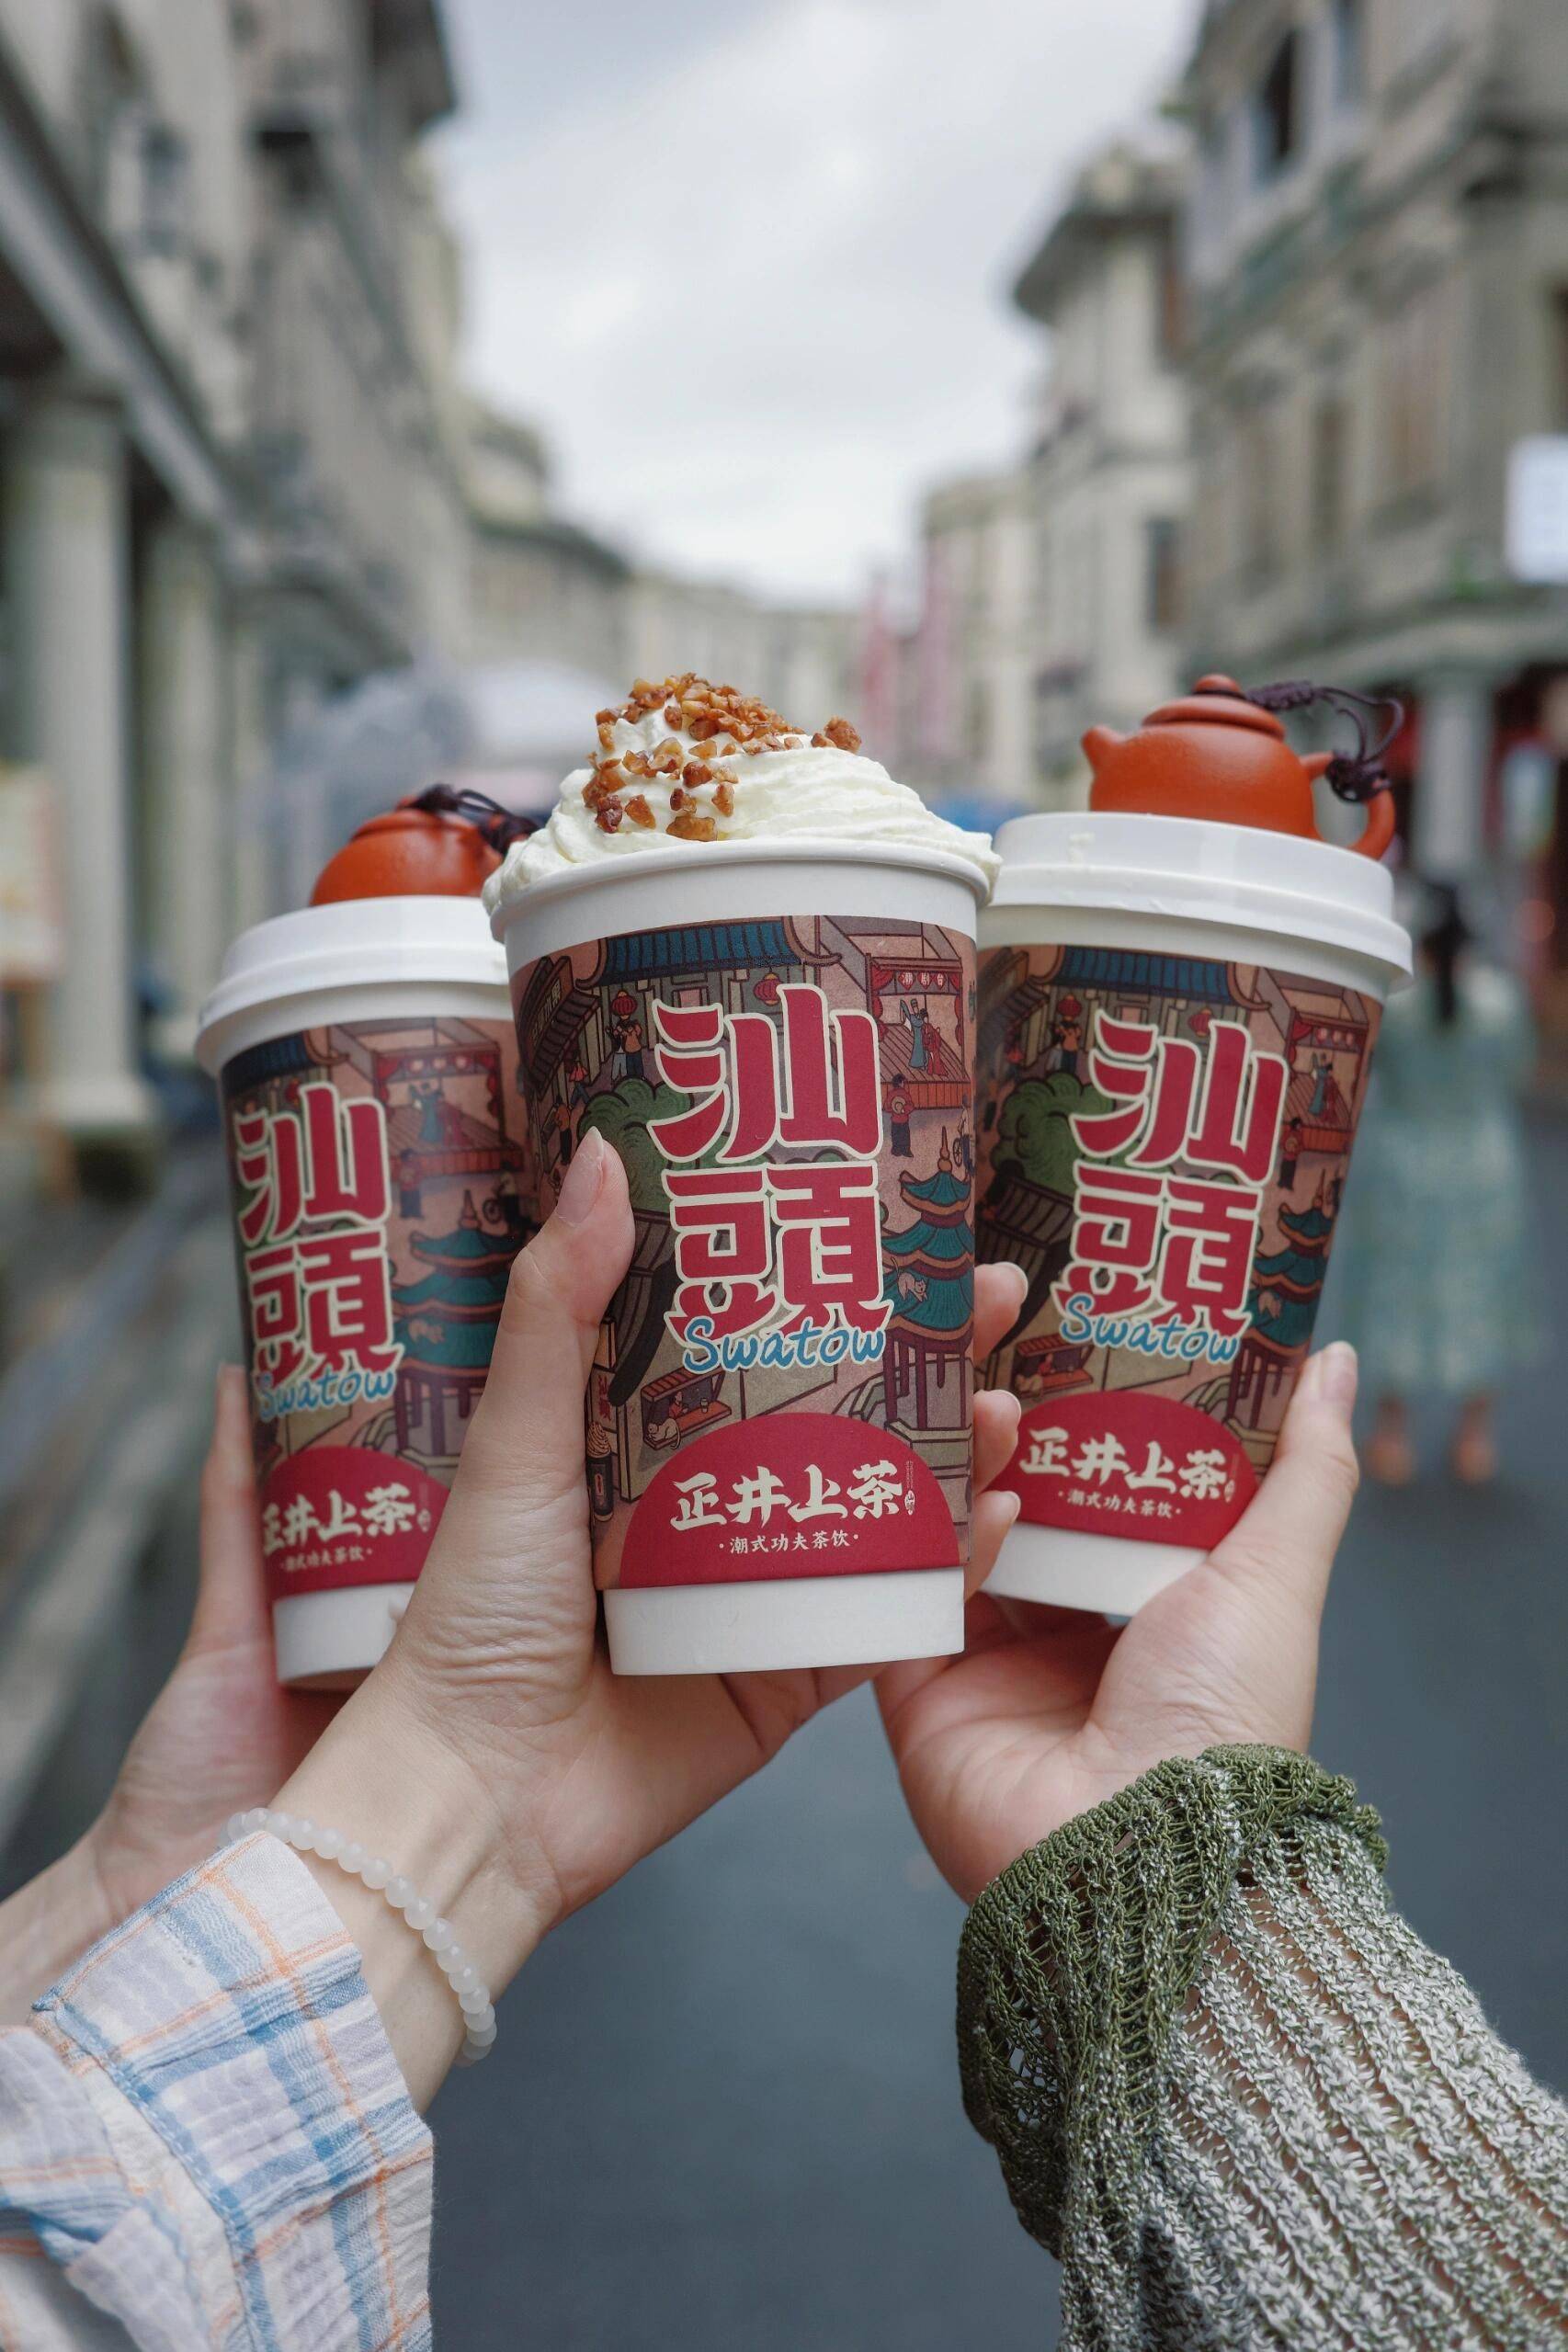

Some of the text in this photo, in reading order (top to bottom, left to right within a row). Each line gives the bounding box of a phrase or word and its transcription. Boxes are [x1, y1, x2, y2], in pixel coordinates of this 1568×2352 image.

[647, 983, 894, 1346] 汕頭
[1050, 1009, 1289, 1338] 汕頭
[234, 1082, 404, 1397] 汕頭
[682, 1316, 886, 1372] Swatow
[1061, 1294, 1240, 1364] Swatow
[258, 1363, 396, 1422] Swatow
[670, 1460, 903, 1531] 正井上茶
[1018, 1426, 1228, 1500] 正井上茶
[1067, 1488, 1173, 1519] 潮式功夫茶饮
[730, 1529, 850, 1554] 潮式功夫茶饮
